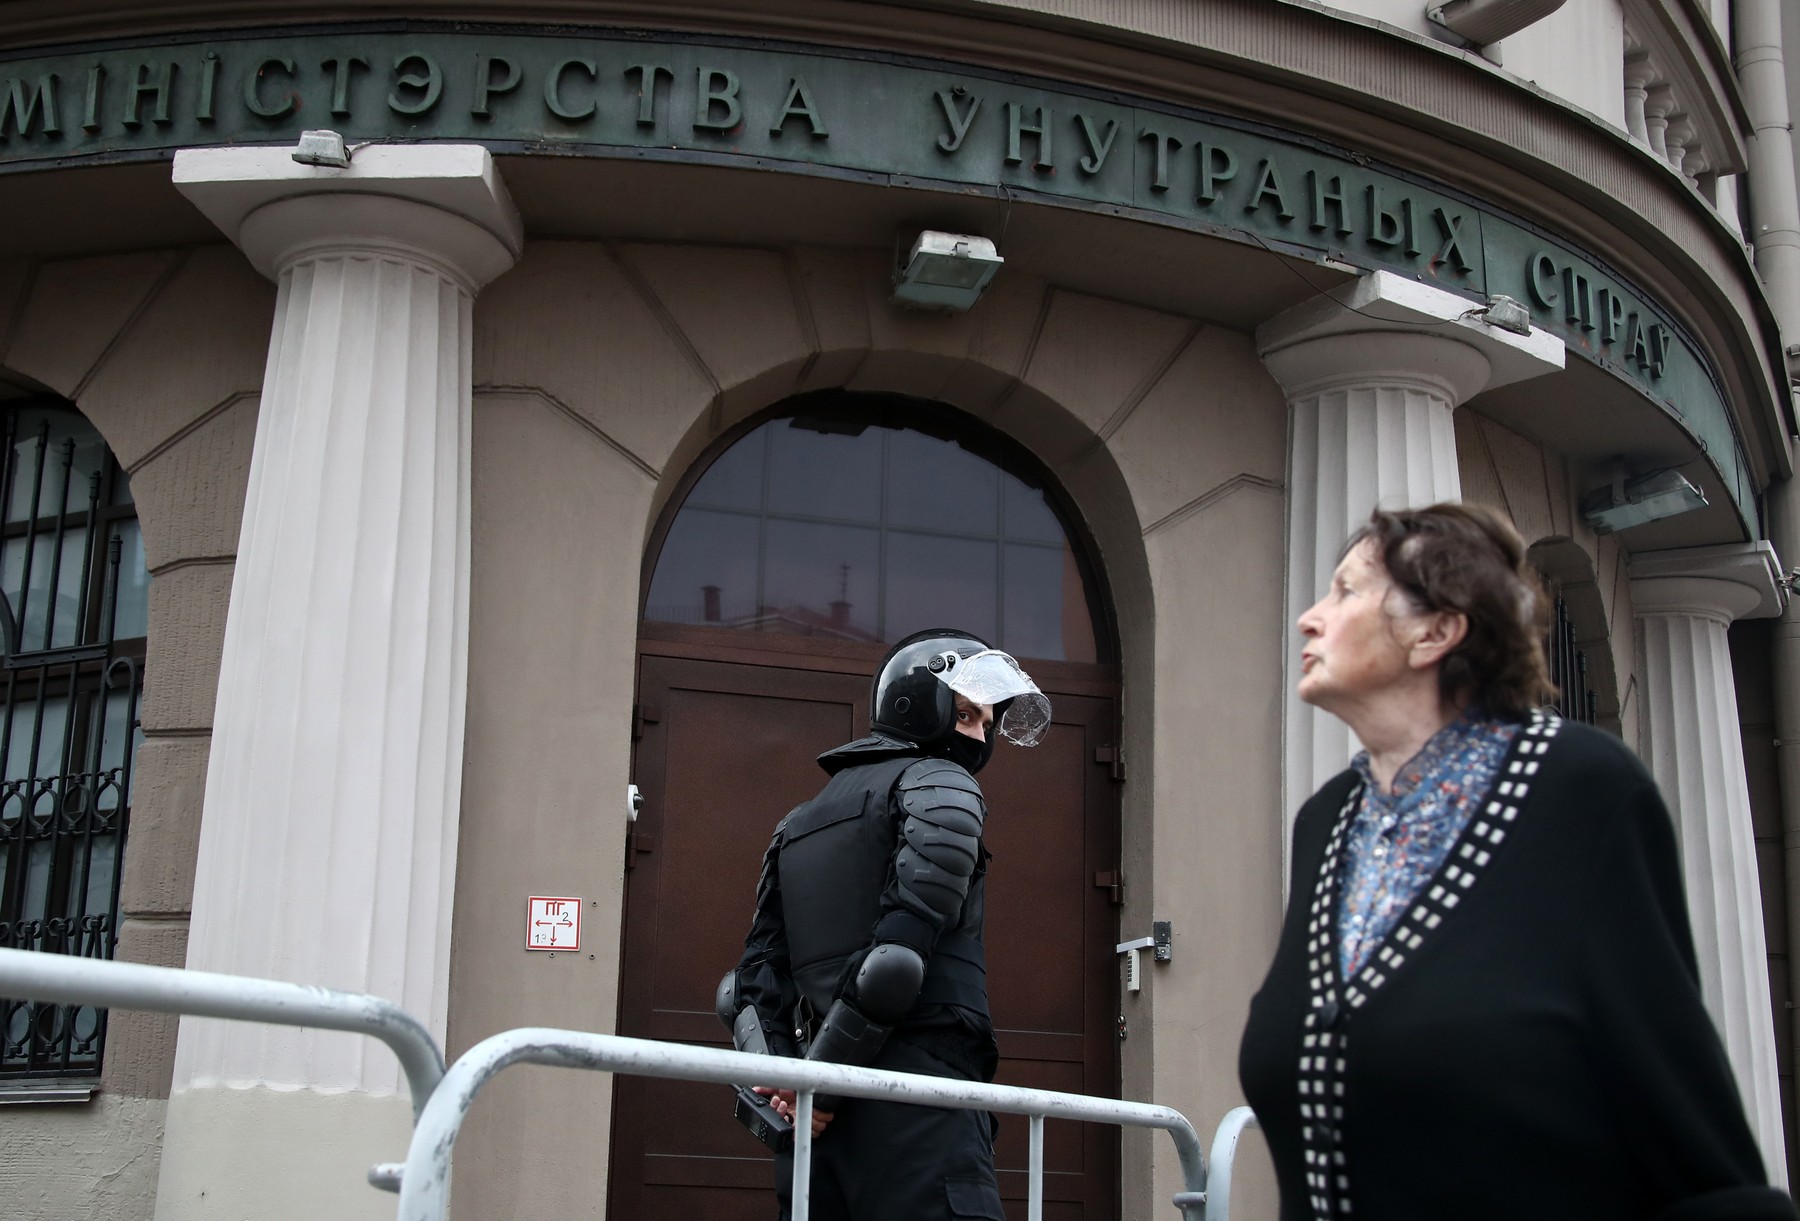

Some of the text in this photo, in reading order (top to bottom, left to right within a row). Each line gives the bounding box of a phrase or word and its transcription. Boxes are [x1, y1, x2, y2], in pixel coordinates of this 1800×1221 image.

[0, 51, 830, 143] МІНІСТЭРСТВА
[545, 901, 566, 916] ПГ
[561, 911, 569, 922] 2
